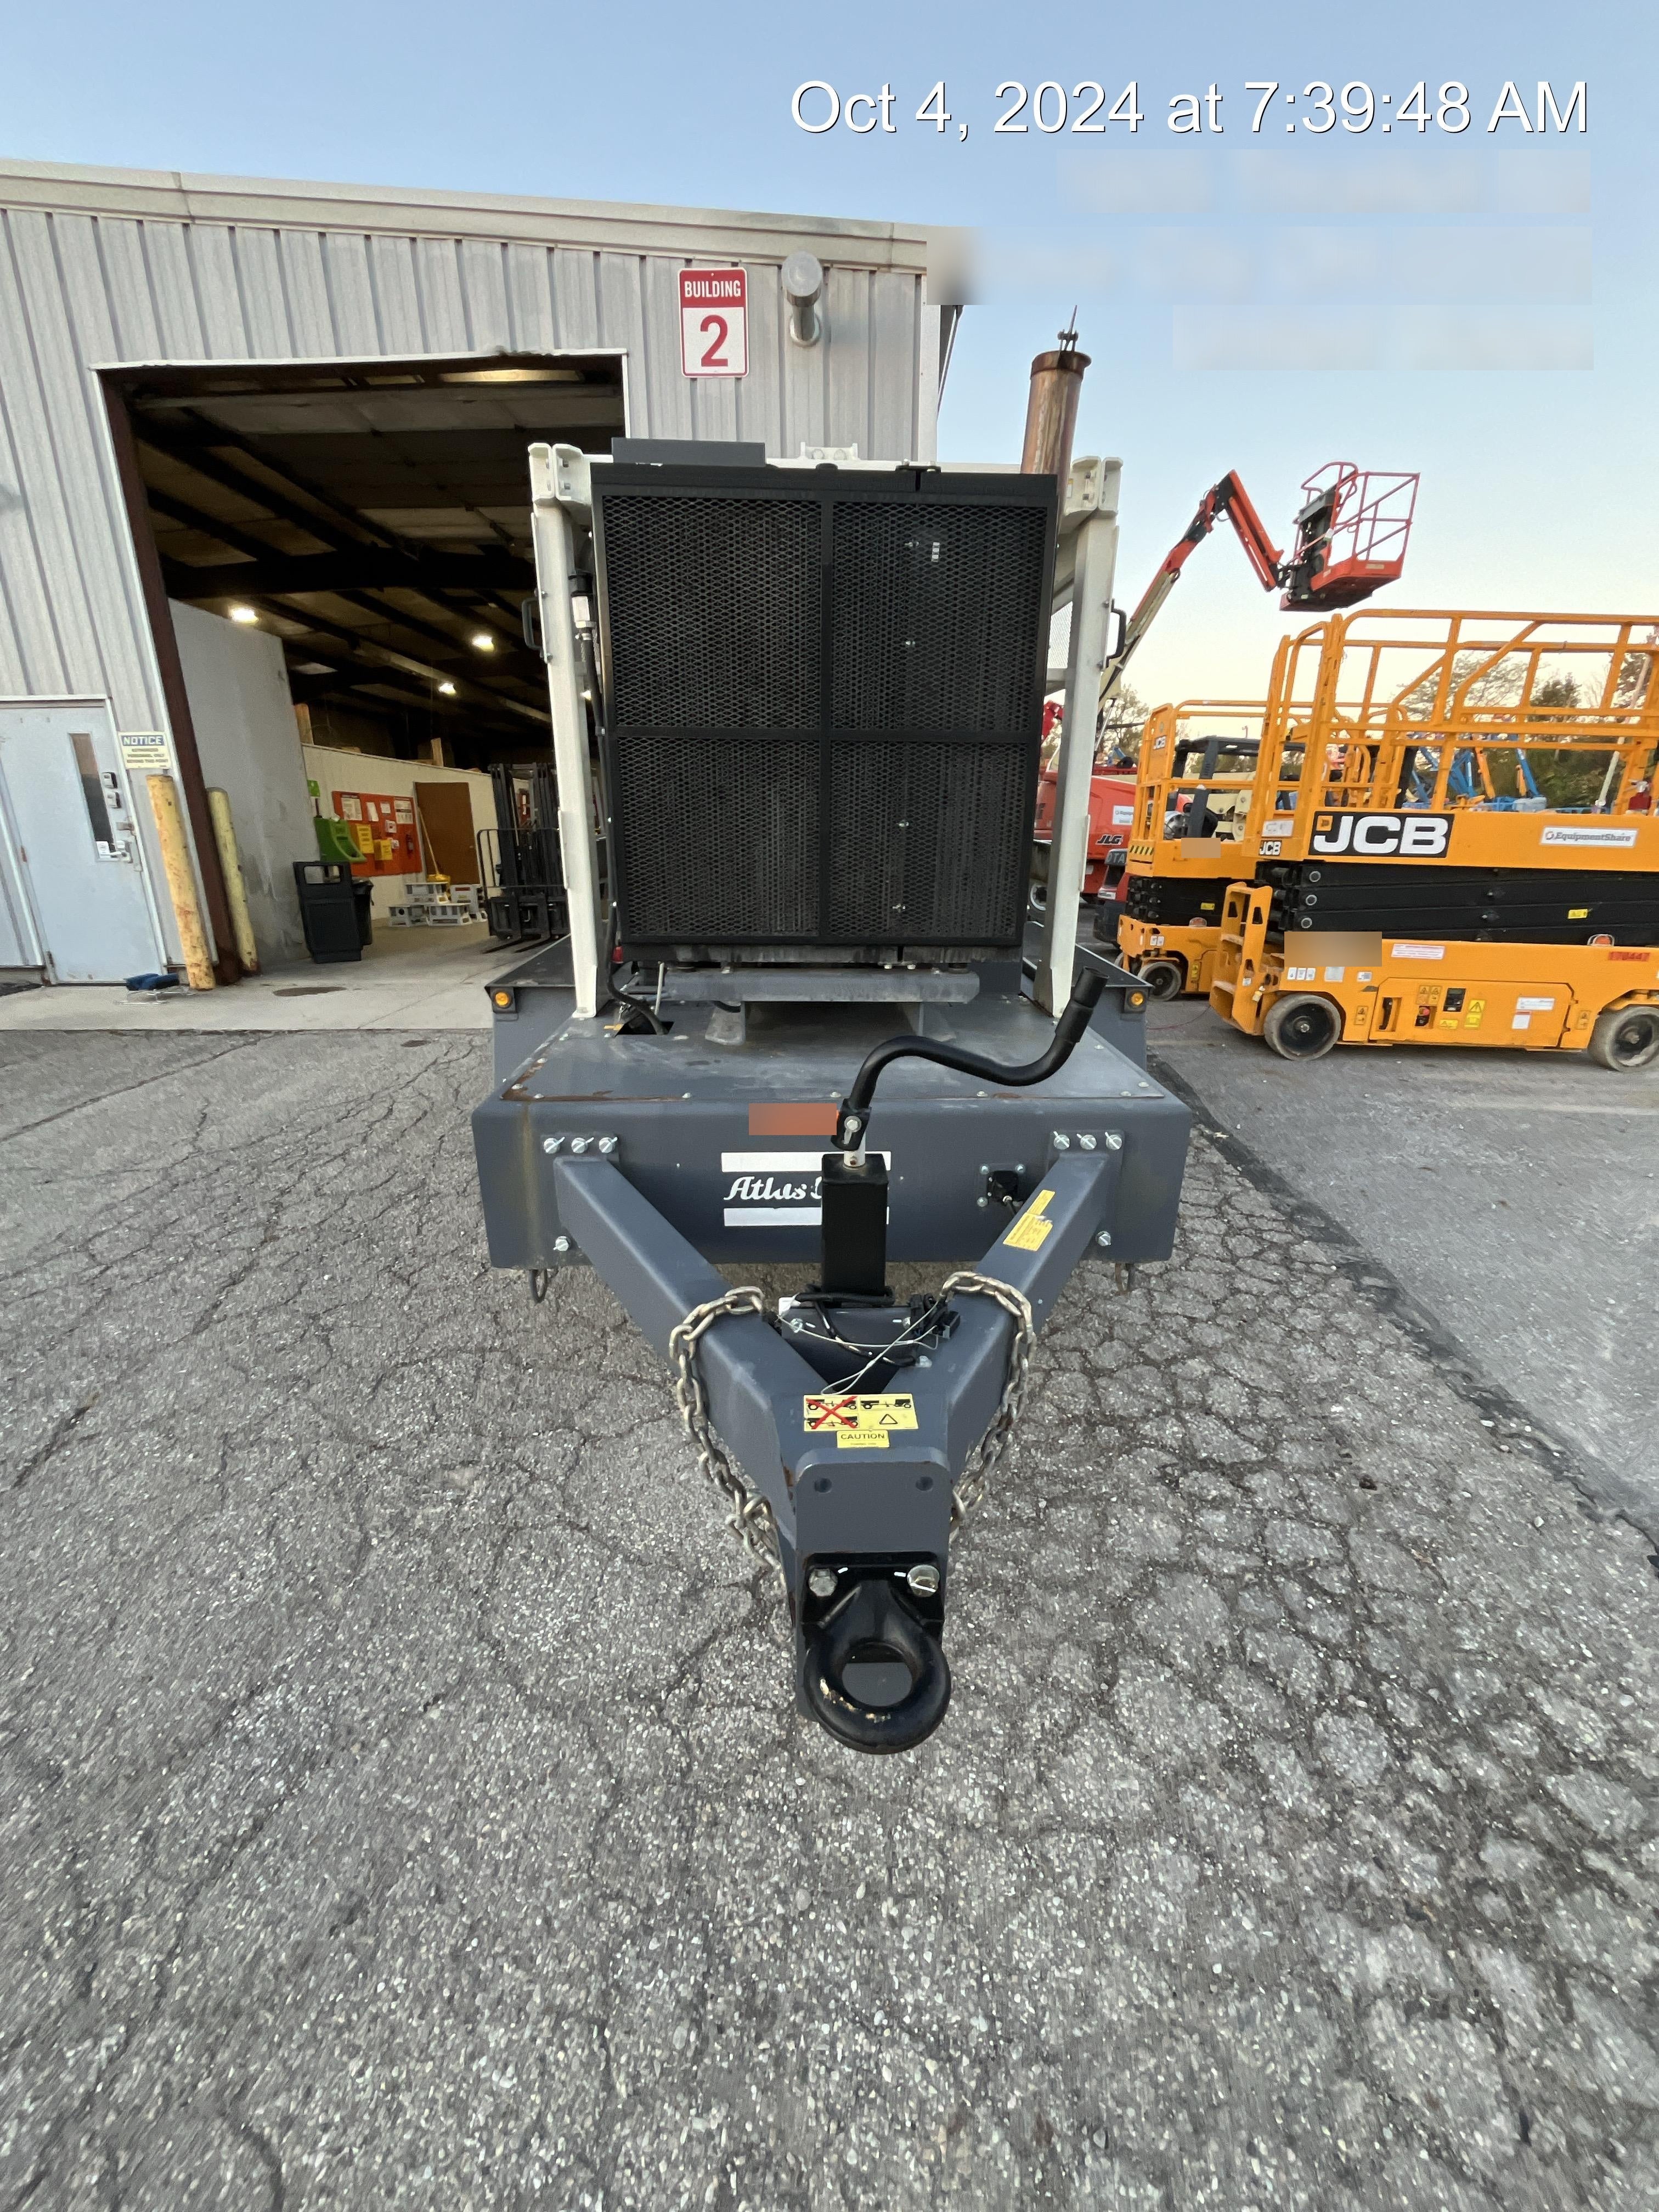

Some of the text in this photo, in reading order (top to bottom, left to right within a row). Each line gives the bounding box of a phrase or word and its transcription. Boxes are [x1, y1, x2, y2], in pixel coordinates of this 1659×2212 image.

[684, 280, 741, 298] BUILDING
[701, 314, 729, 366] 2
[123, 736, 162, 745] NOTICE
[1096, 834, 1123, 845] JLG
[1313, 816, 1449, 855] JCB
[1554, 832, 1632, 842] EquipmentShare
[1260, 841, 1282, 855] JCB
[723, 1176, 808, 1200] Atlas
